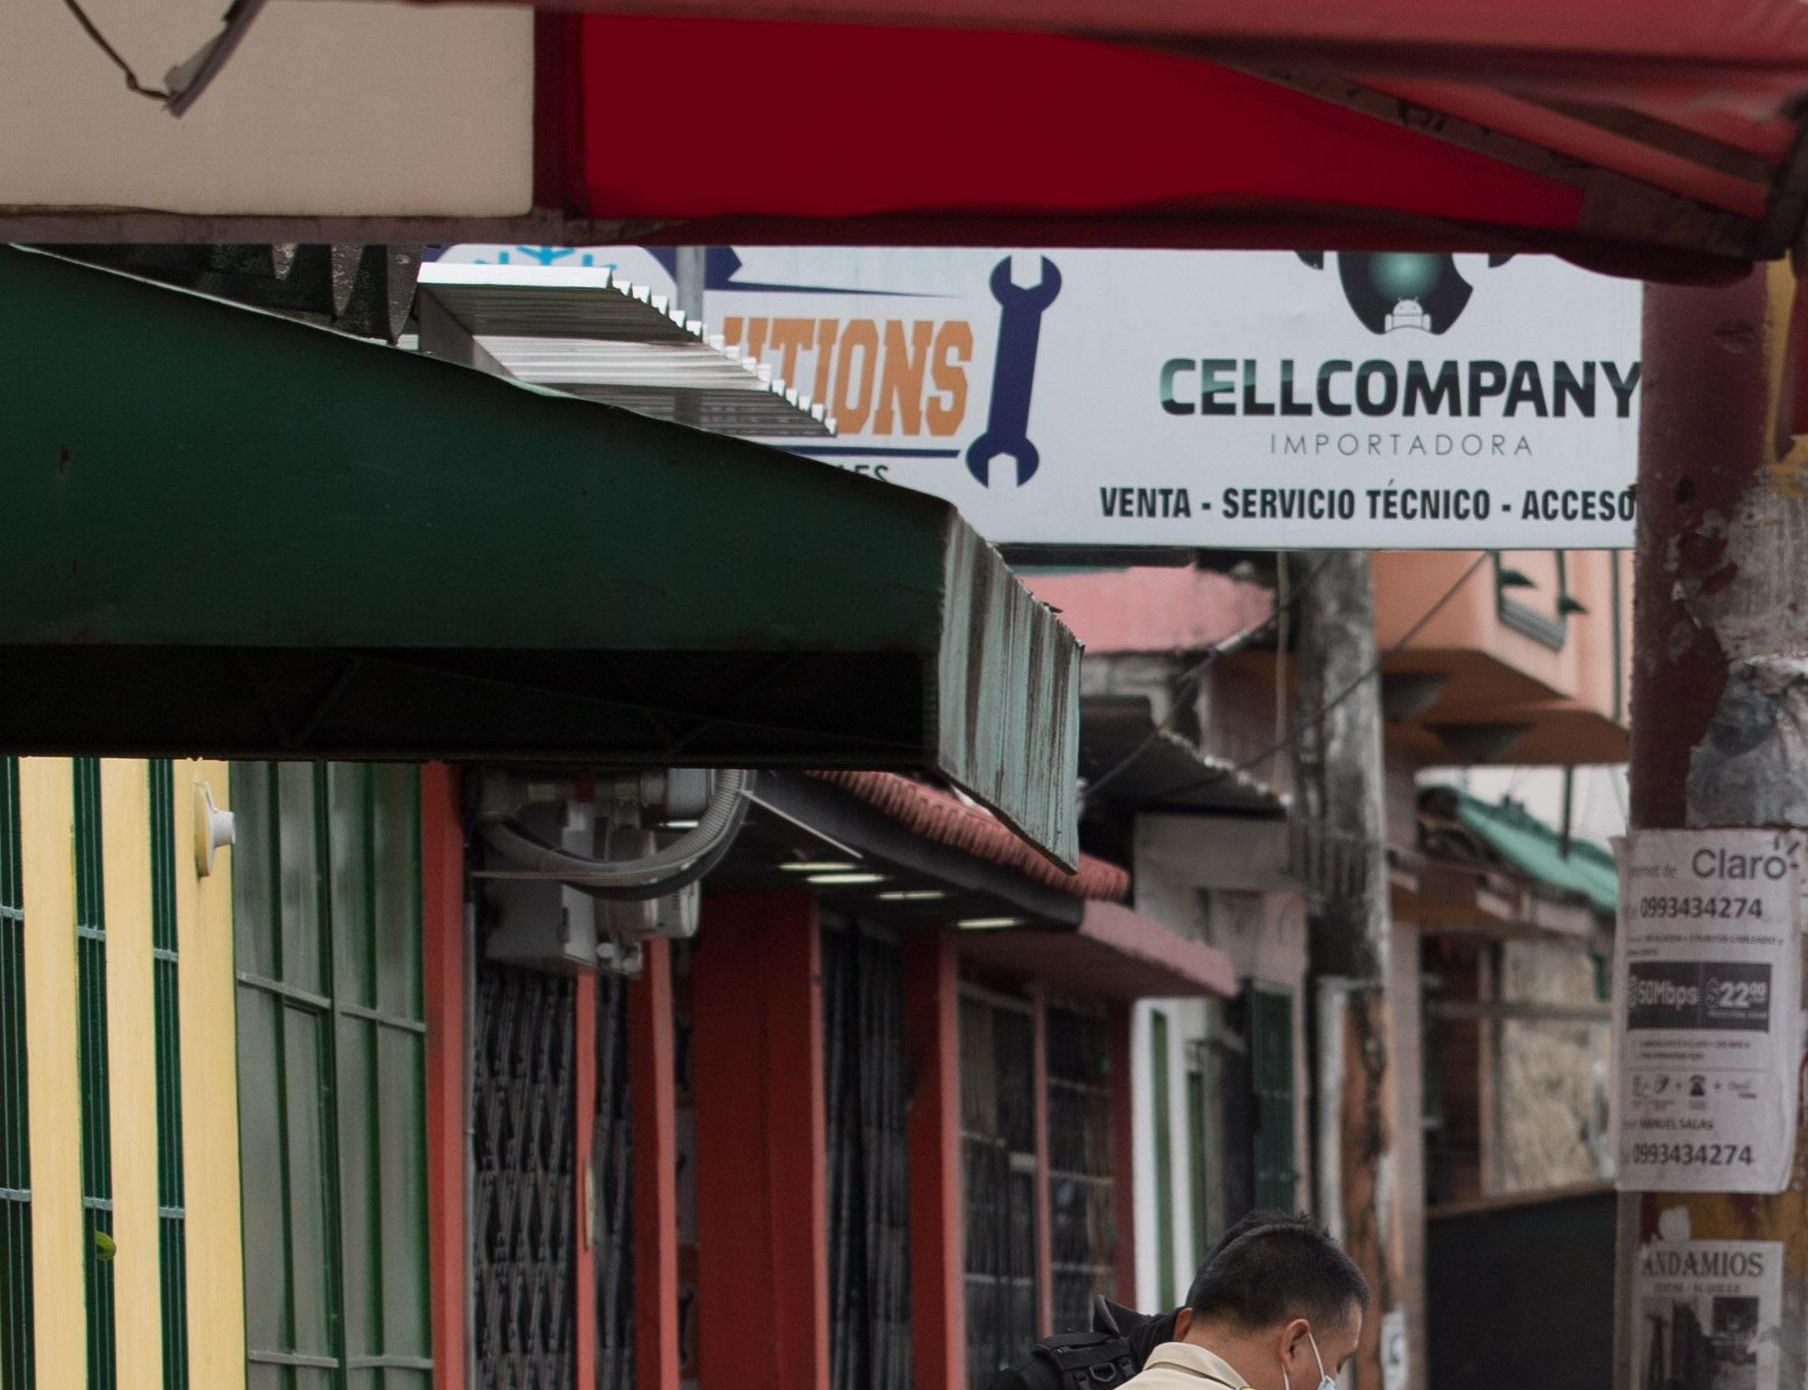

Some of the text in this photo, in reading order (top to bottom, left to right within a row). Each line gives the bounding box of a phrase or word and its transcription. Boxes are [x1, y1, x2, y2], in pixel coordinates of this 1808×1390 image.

[1159, 358, 1641, 418] CELLCOMPANY
[1271, 432, 1533, 456] IMPORTADORA
[1100, 486, 1191, 518] VENTA
[1222, 487, 1355, 520] SERVICIO
[1367, 478, 1490, 520] TÉCNICO
[1692, 847, 1787, 881] Claro
[1642, 1250, 1764, 1278] ANDAMIOS
